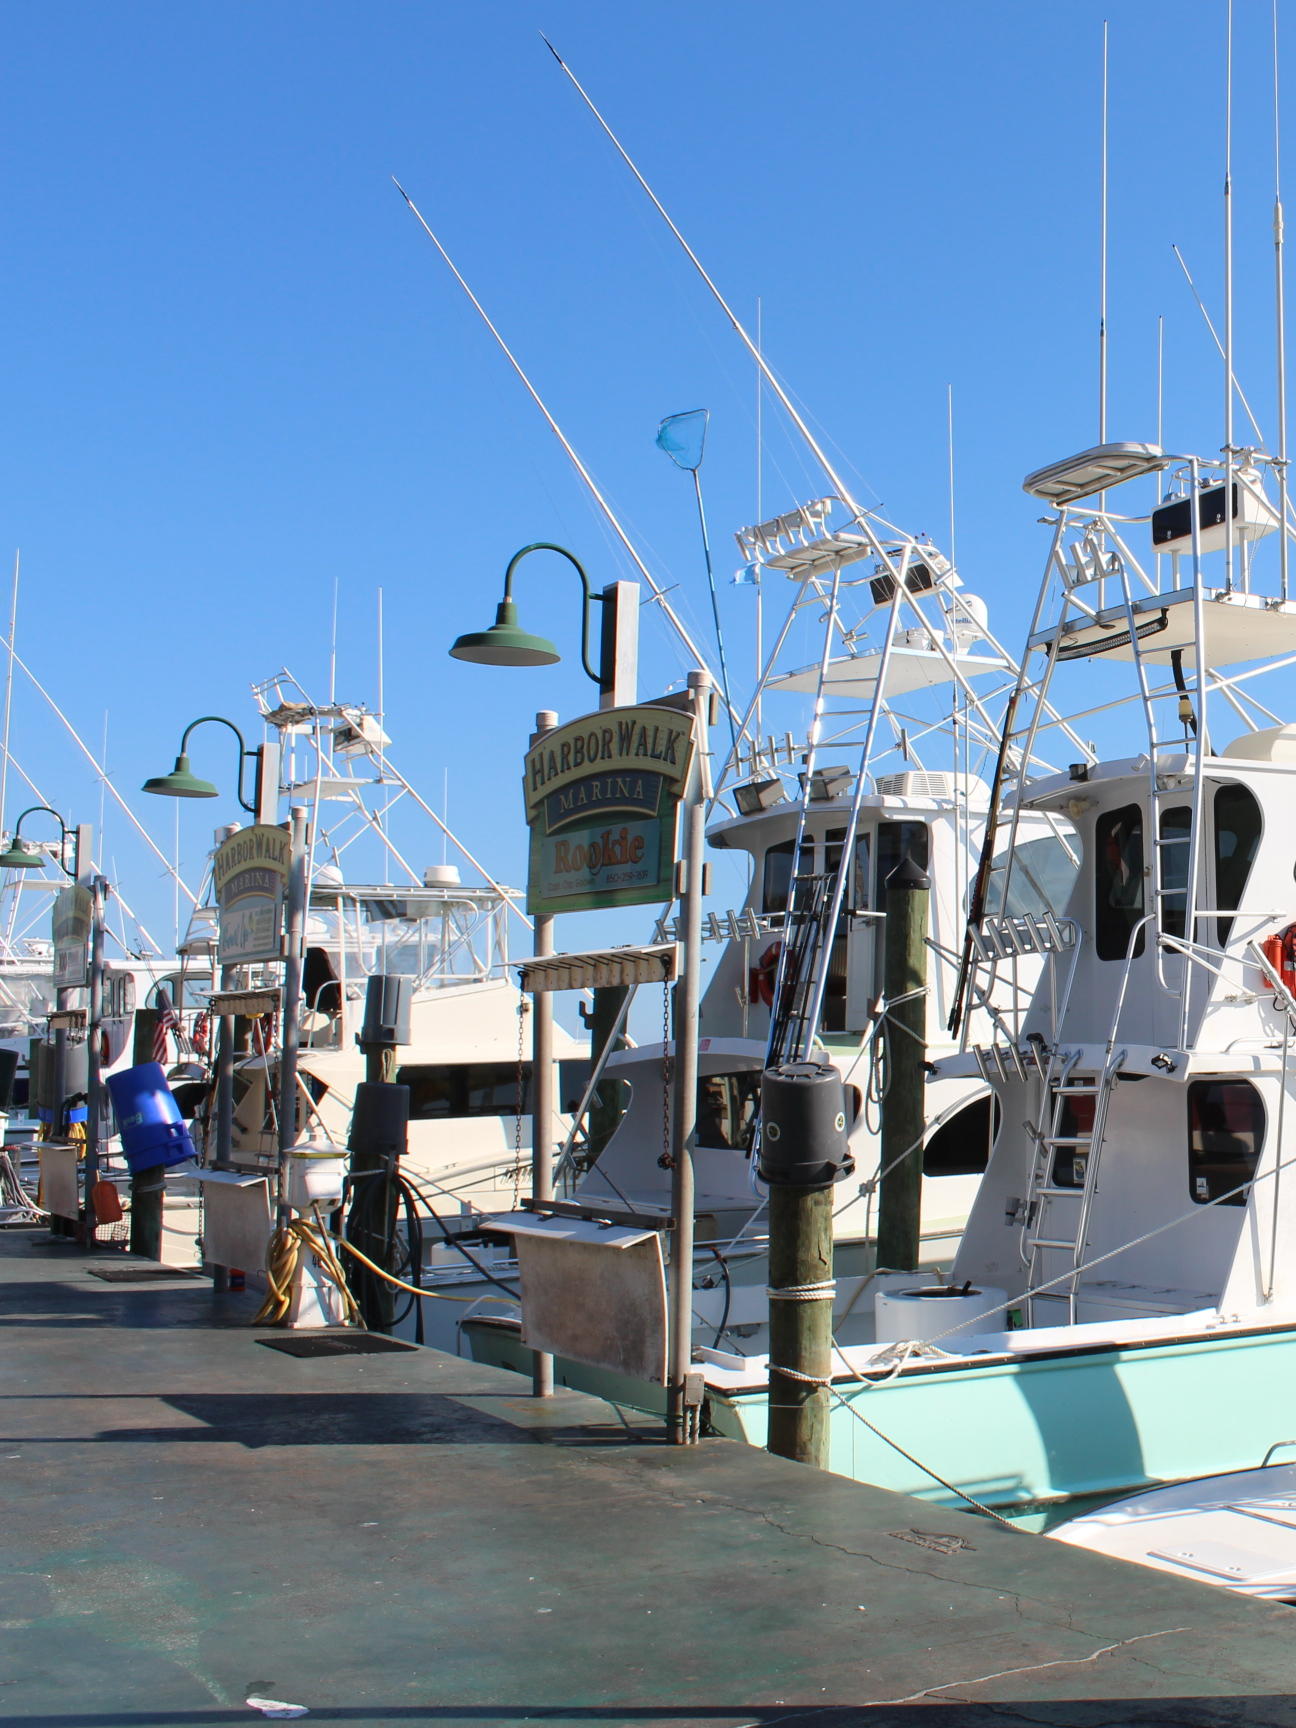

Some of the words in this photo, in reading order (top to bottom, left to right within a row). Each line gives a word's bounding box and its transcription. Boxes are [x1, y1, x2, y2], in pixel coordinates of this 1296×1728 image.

[559, 775, 645, 813] MARINA
[553, 826, 646, 876] Rookie
[230, 870, 271, 894] MARINA
